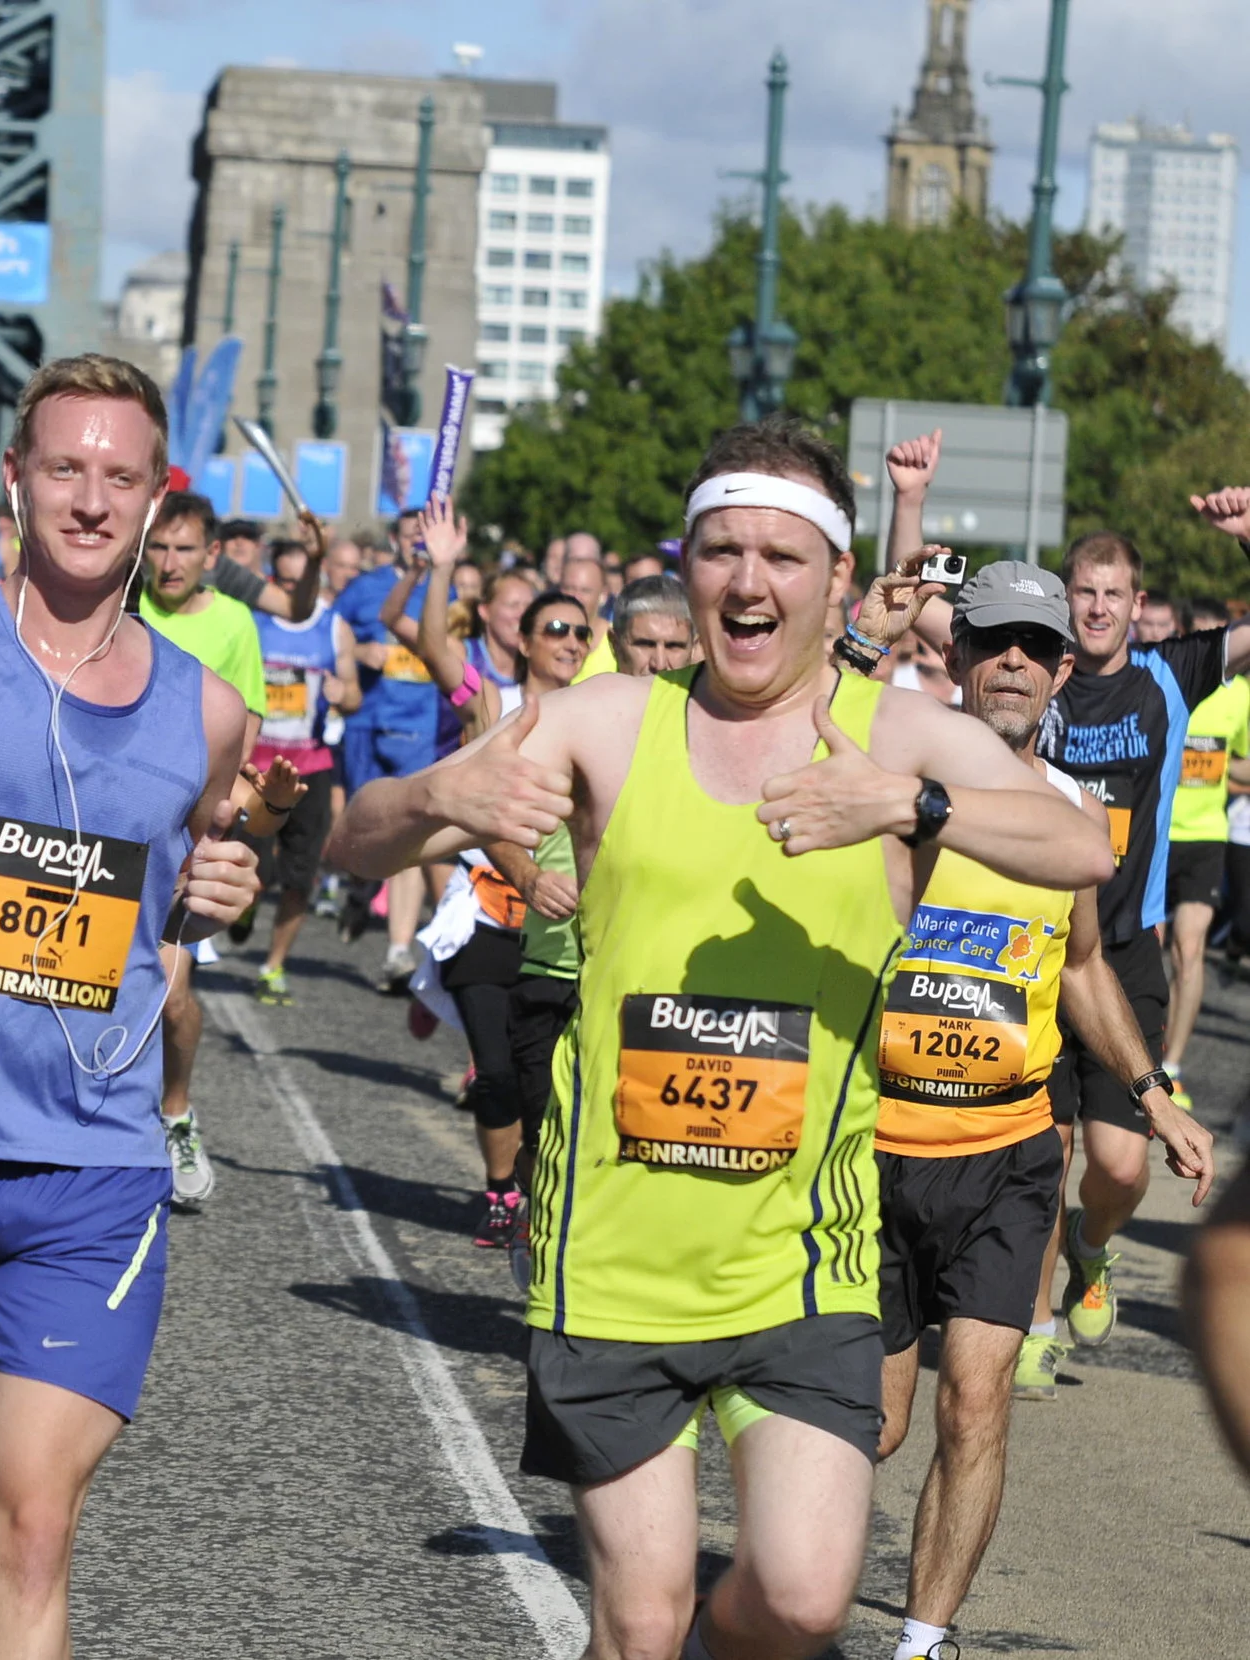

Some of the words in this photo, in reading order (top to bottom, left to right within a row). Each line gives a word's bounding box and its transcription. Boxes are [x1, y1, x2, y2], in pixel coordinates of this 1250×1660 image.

[1064, 740, 1125, 764] CANCER
[1128, 734, 1149, 759] UK
[915, 912, 958, 933] Marie
[962, 919, 1000, 940] Curie
[959, 938, 993, 960] Care
[22, 952, 57, 970] PUMA
[108, 968, 117, 981] C
[910, 974, 986, 1009] Bupa
[650, 996, 750, 1043] Bupa
[938, 1018, 972, 1032] MARK
[909, 1029, 1001, 1062] 12042
[686, 1057, 732, 1073] DAVID
[937, 1067, 964, 1079] PUMA
[1010, 1072, 1017, 1081] D
[660, 1074, 758, 1113] 6437
[685, 1125, 721, 1138] PUMA
[784, 1131, 794, 1143] C
[626, 1142, 789, 1171] #GNRMILLION
